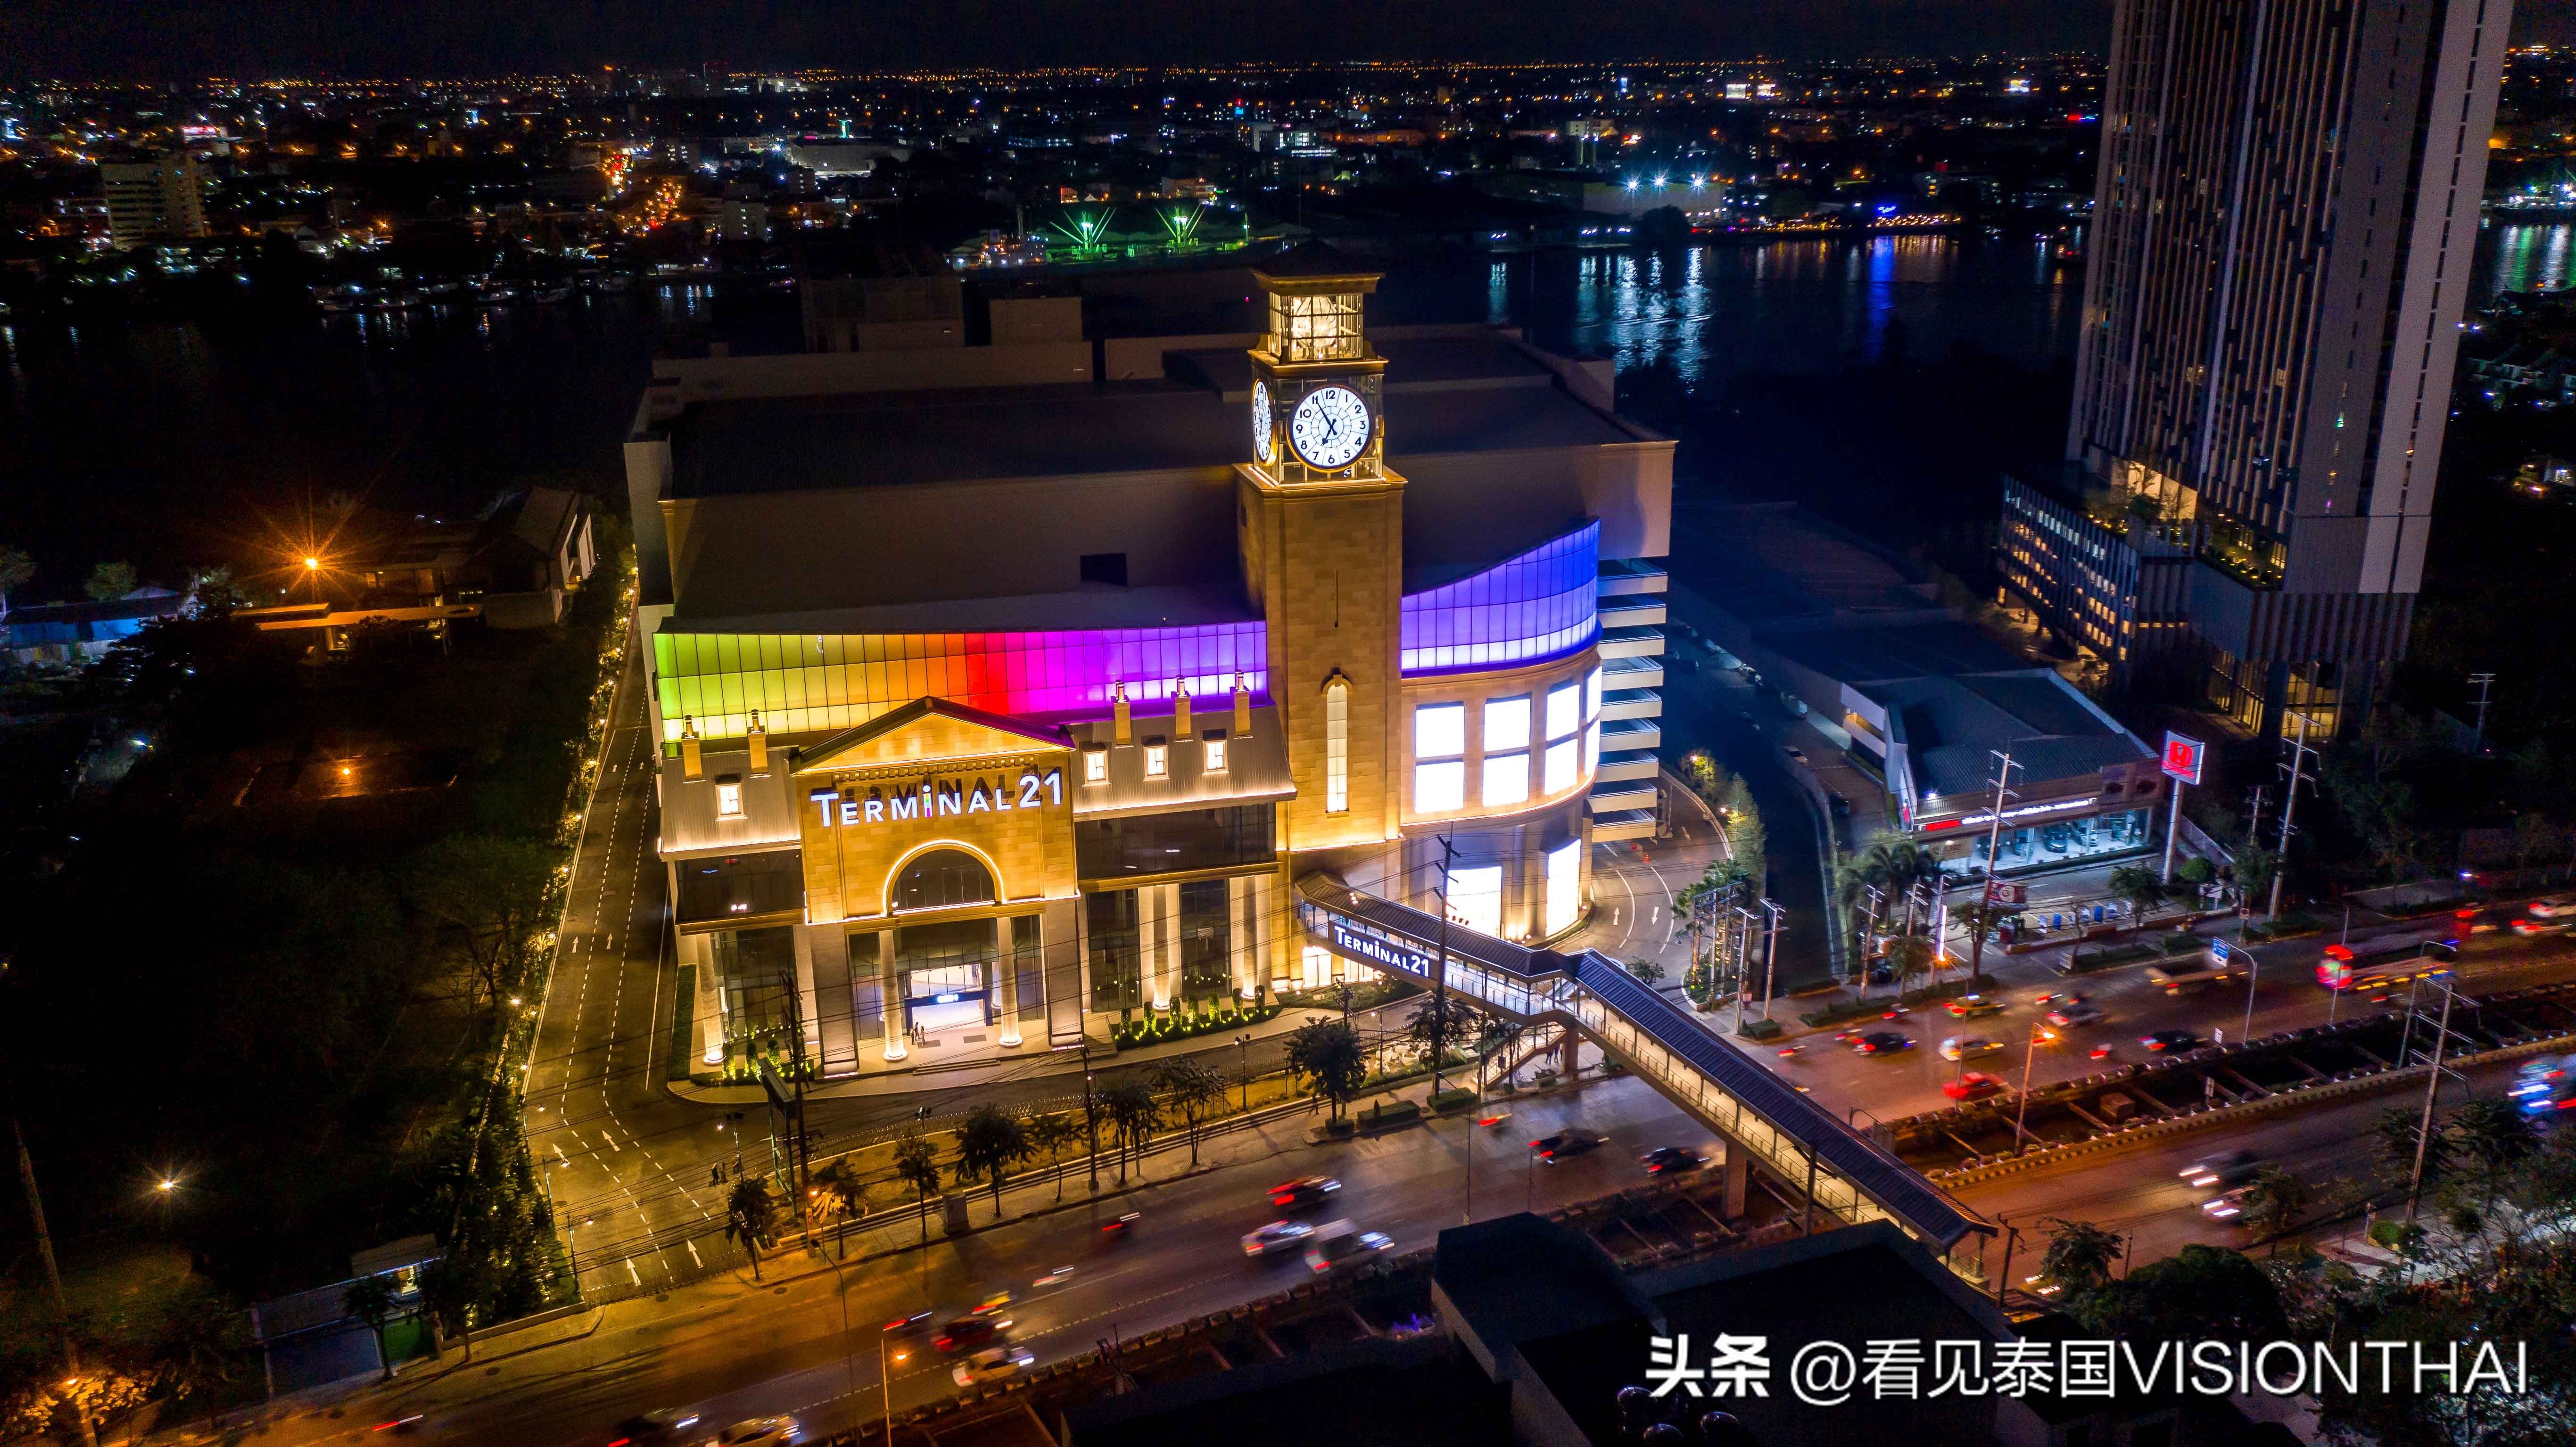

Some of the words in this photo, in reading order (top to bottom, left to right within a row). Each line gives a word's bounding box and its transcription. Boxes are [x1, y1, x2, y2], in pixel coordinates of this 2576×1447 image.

[1326, 390, 1336, 399] 12
[1346, 394, 1348, 403] 1
[1312, 395, 1318, 404] 11
[1300, 409, 1312, 419] 10
[1354, 405, 1362, 414] 2
[1296, 424, 1303, 434] 9
[1360, 420, 1366, 430] 3
[1301, 440, 1307, 450] 8
[1354, 437, 1362, 446] 4
[1313, 452, 1319, 460] 7
[1344, 449, 1351, 458] 5
[1328, 454, 1335, 464] 6
